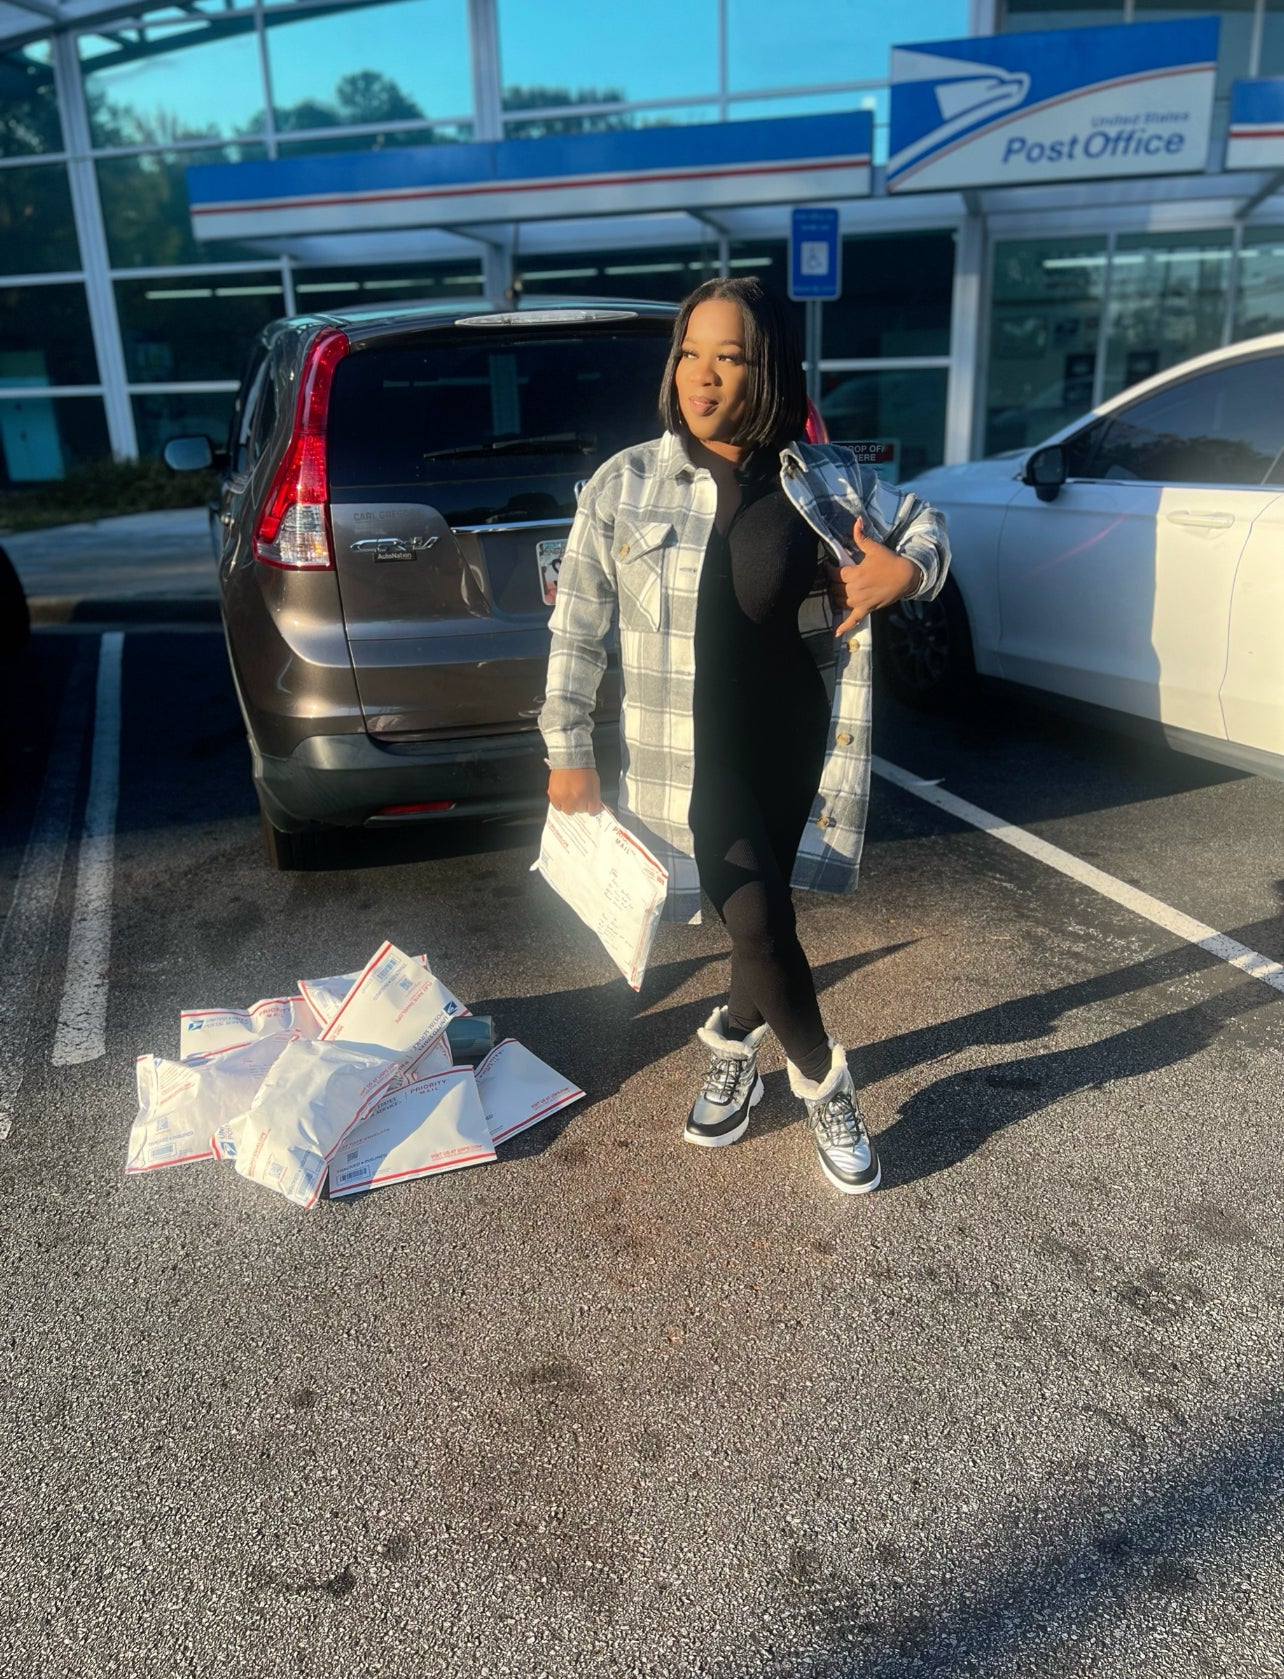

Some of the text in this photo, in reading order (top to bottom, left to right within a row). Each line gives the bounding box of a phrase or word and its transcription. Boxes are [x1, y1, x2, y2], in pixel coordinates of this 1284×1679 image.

[1091, 111, 1190, 127] United States
[1002, 128, 1186, 165] Post Office
[856, 454, 876, 462] ERE
[353, 511, 376, 521] CARL
[377, 551, 412, 560] AutoNation
[410, 1079, 447, 1094] PRIORITY
[419, 1086, 440, 1095] MAIL
